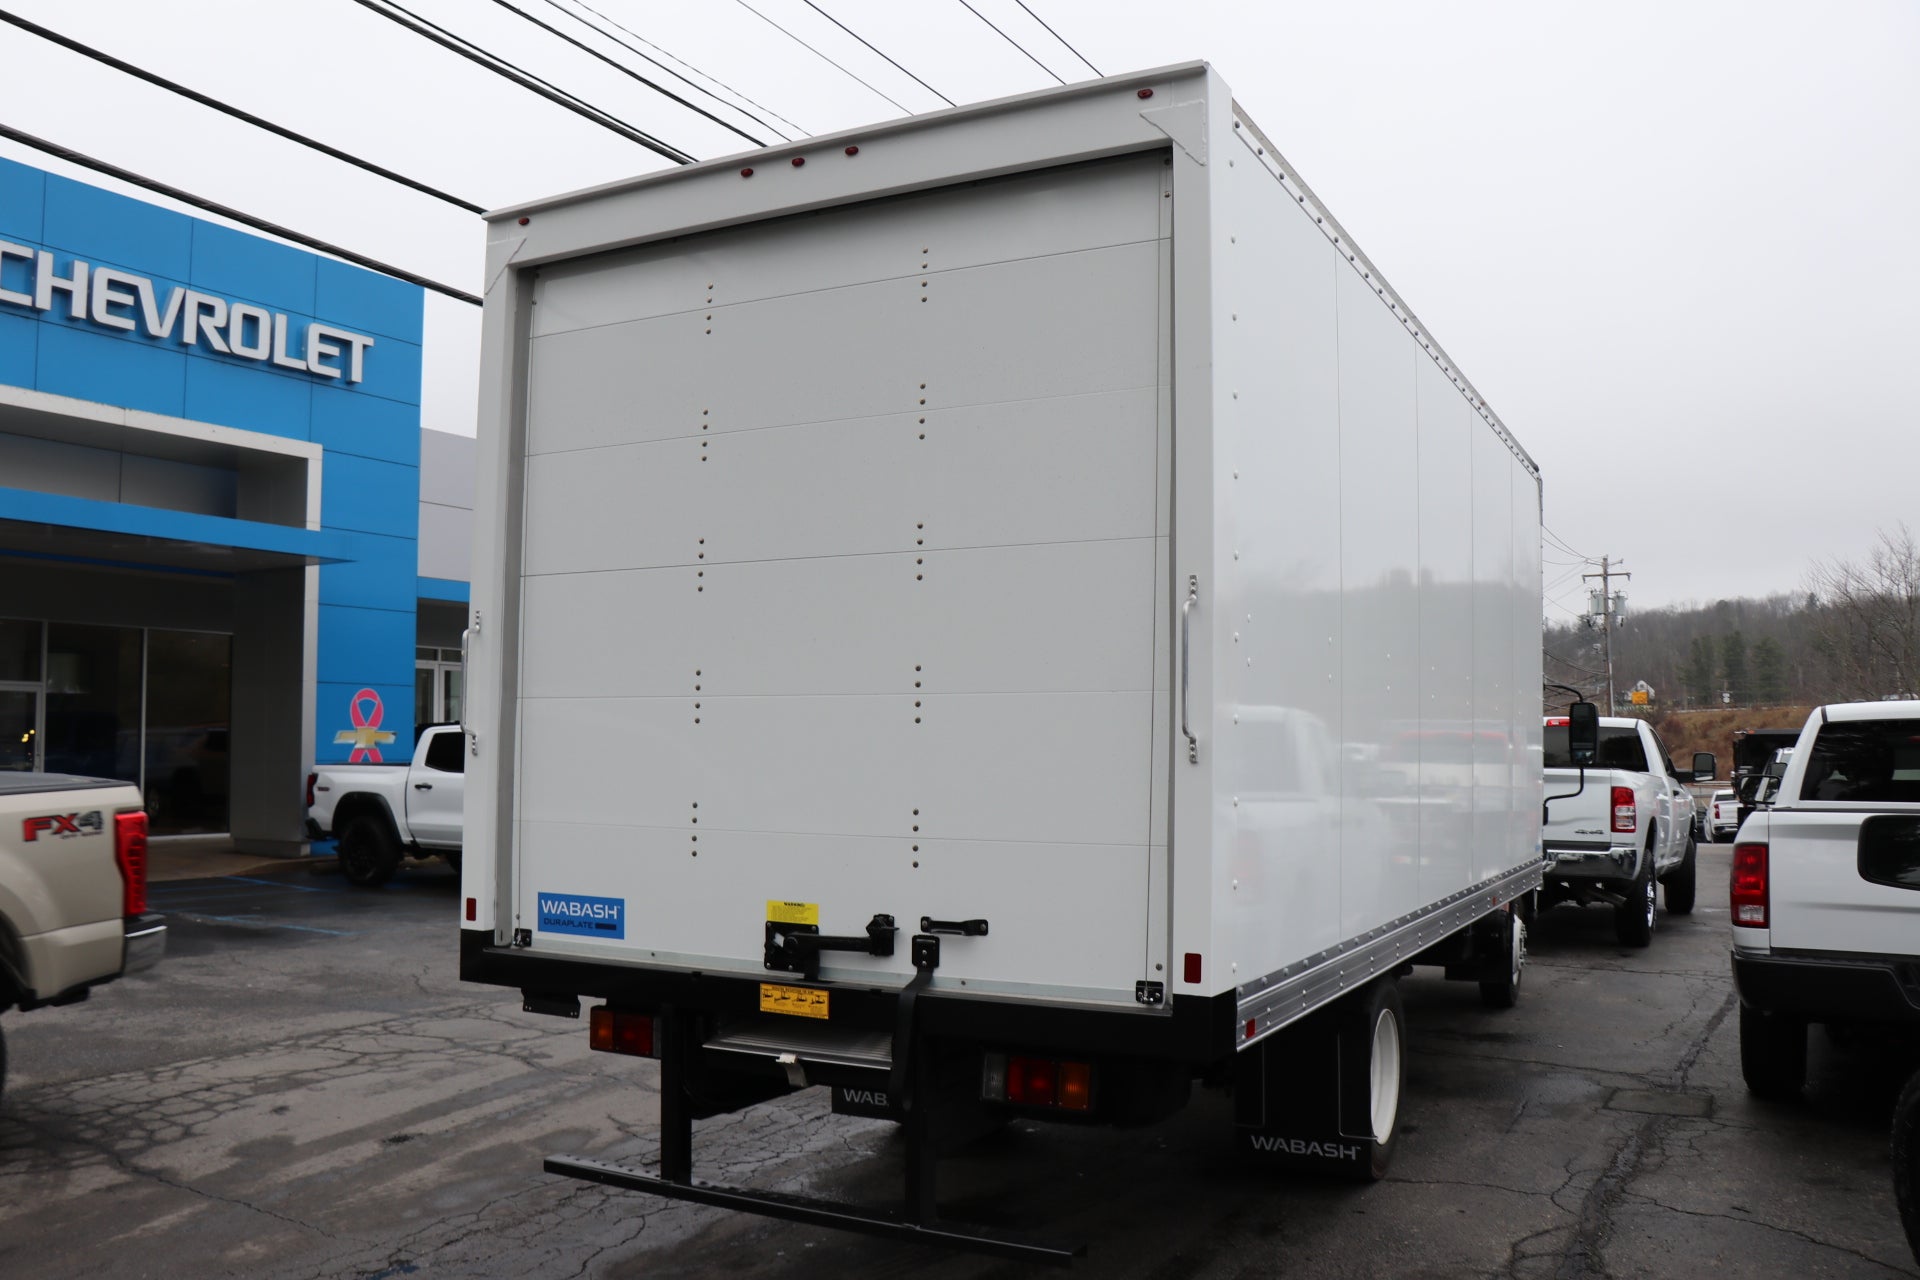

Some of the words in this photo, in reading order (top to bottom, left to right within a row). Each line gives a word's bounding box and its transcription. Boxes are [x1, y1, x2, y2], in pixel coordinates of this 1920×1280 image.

[0, 239, 374, 383] CHEVROLET
[23, 811, 103, 842] FX4
[541, 899, 618, 920] WABASH
[543, 917, 594, 929] DURAPLATE
[843, 1088, 890, 1107] WAB
[1251, 1135, 1357, 1161] WABASH
